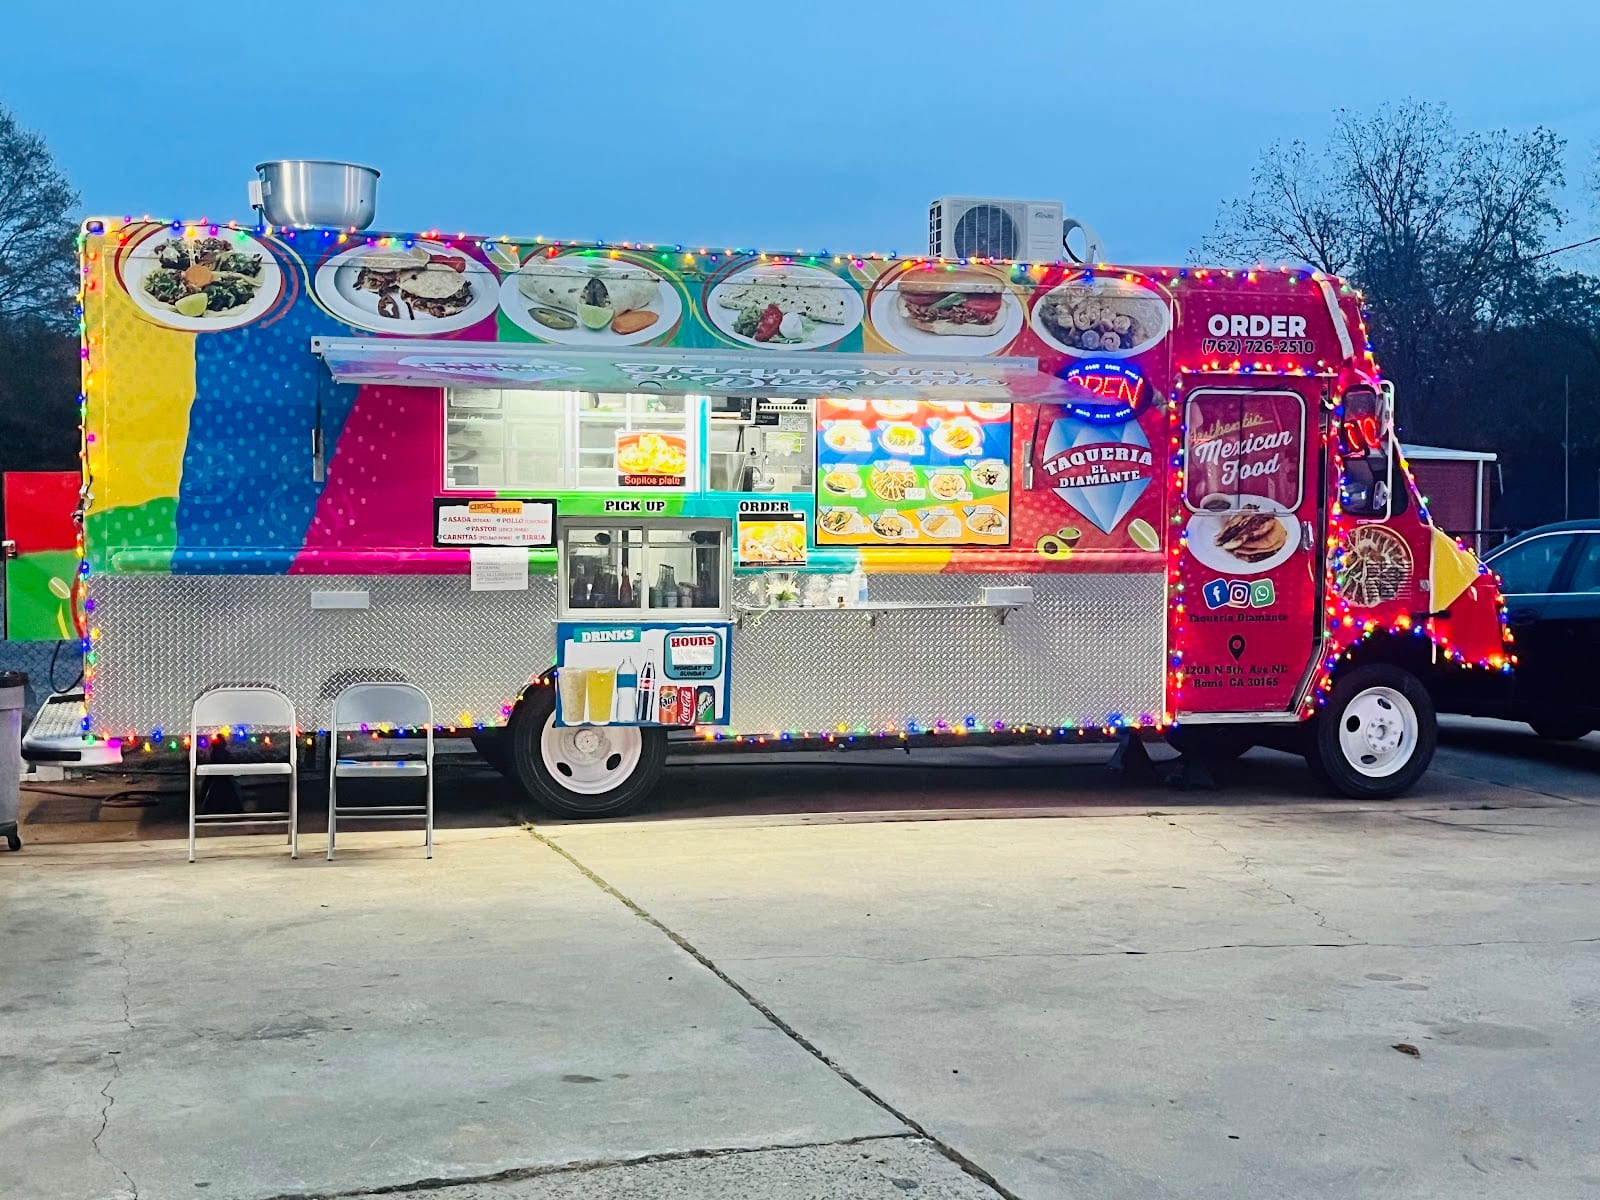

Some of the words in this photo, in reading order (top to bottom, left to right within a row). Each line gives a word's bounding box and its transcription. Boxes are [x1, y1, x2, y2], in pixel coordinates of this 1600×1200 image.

[1208, 314, 1307, 338] ORDER
[1202, 338, 1242, 355] (762)
[1246, 339, 1315, 354] 726-2510
[1195, 430, 1293, 466] Mexican
[1043, 447, 1152, 476] TAQUERIA
[1091, 465, 1107, 474] EL
[1221, 453, 1281, 486] Food
[658, 475, 681, 486] plate
[1059, 471, 1141, 488] DIAMANTE
[605, 501, 640, 512] PICK
[646, 501, 665, 512] UP
[739, 501, 790, 512] ORDER
[581, 628, 635, 642] DRINKS
[671, 635, 715, 648] HOURS
[1214, 665, 1223, 674] N
[1226, 665, 1244, 674] 5th
[1193, 678, 1223, 688] Rome
[1247, 677, 1279, 687] 30165
